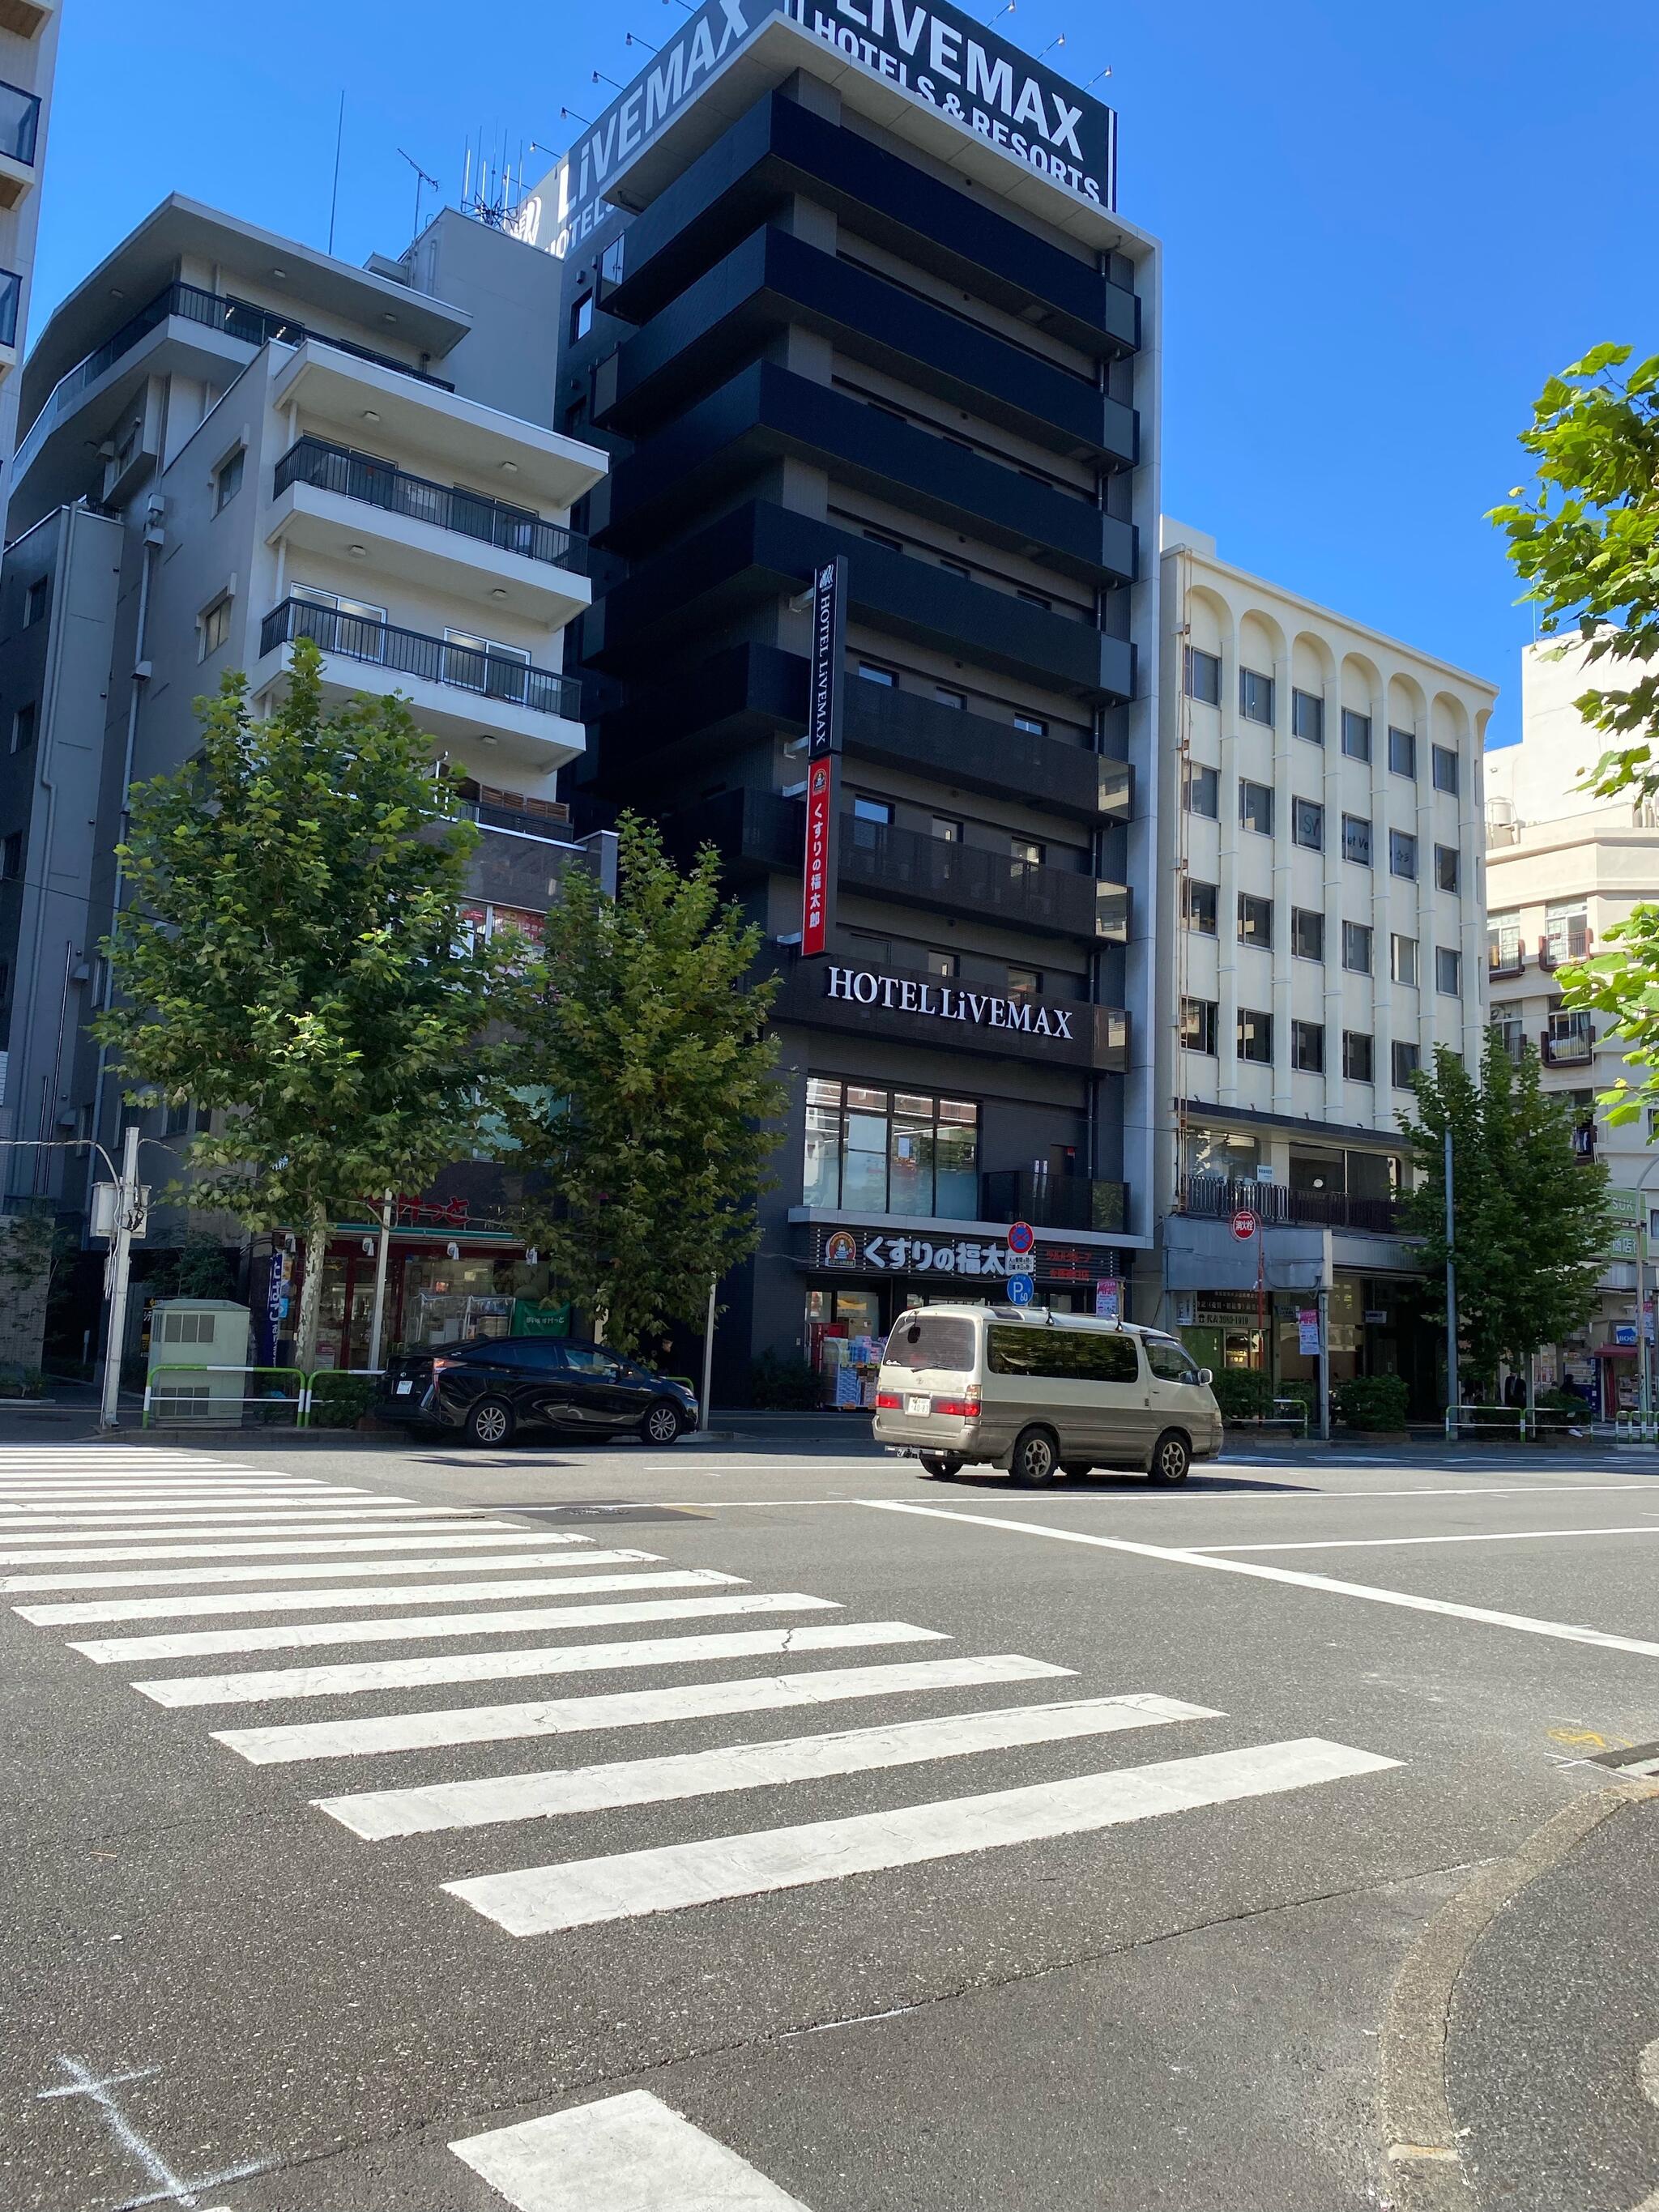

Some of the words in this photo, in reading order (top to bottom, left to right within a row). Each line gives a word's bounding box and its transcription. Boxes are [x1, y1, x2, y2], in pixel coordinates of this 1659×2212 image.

[942, 92, 966, 121] &
[819, 595, 830, 658] HOTEL
[809, 803, 823, 929] くすりの福太郎
[827, 966, 936, 1015] HOTEL
[940, 987, 1073, 1040] LiVEMAX
[1235, 1220, 1253, 1231] 消火栓
[864, 1235, 1028, 1276] くすりの福太
[1013, 1282, 1024, 1302] P
[1021, 1293, 1028, 1302] 60
